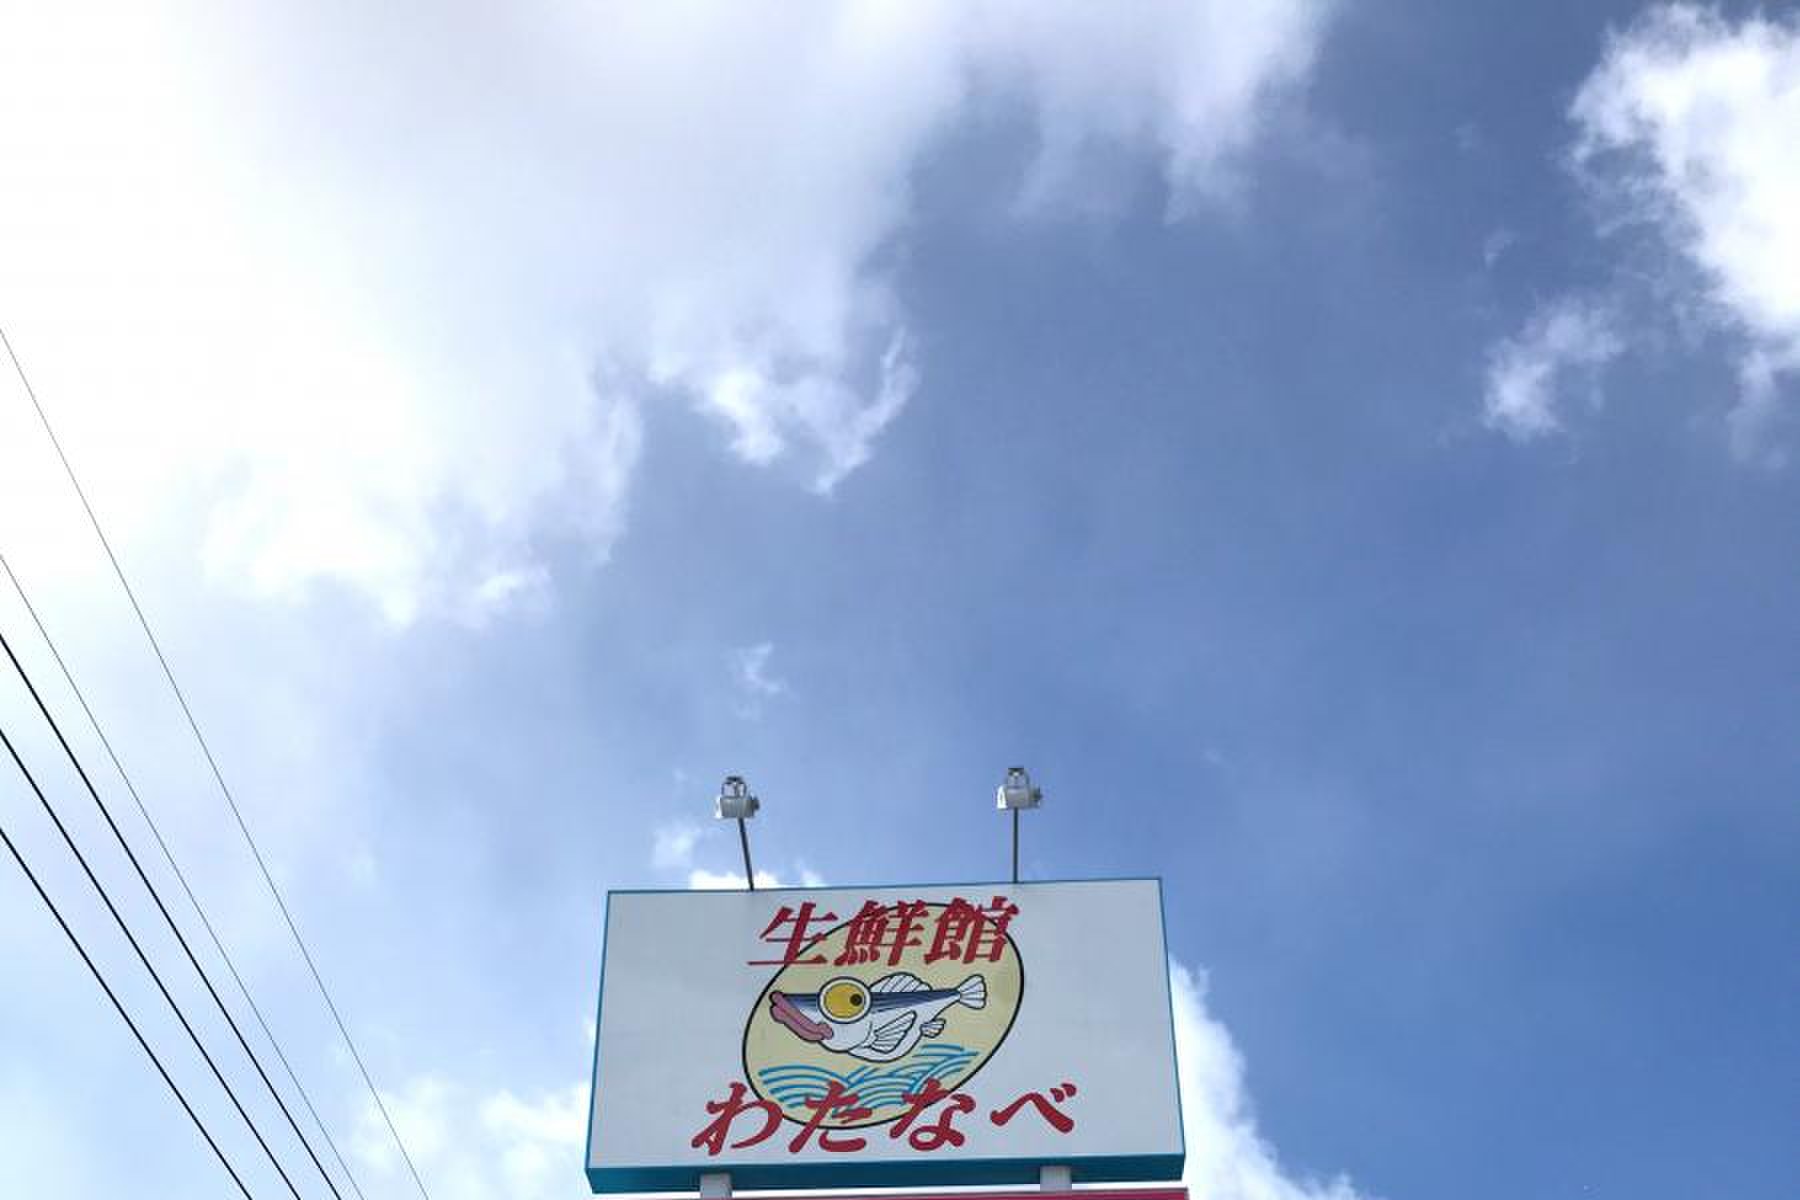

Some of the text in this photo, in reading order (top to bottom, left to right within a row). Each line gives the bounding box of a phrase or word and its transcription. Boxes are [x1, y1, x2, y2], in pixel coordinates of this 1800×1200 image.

[747, 895, 1020, 967] 生鮮館
[690, 1078, 1078, 1156] わたなべ
